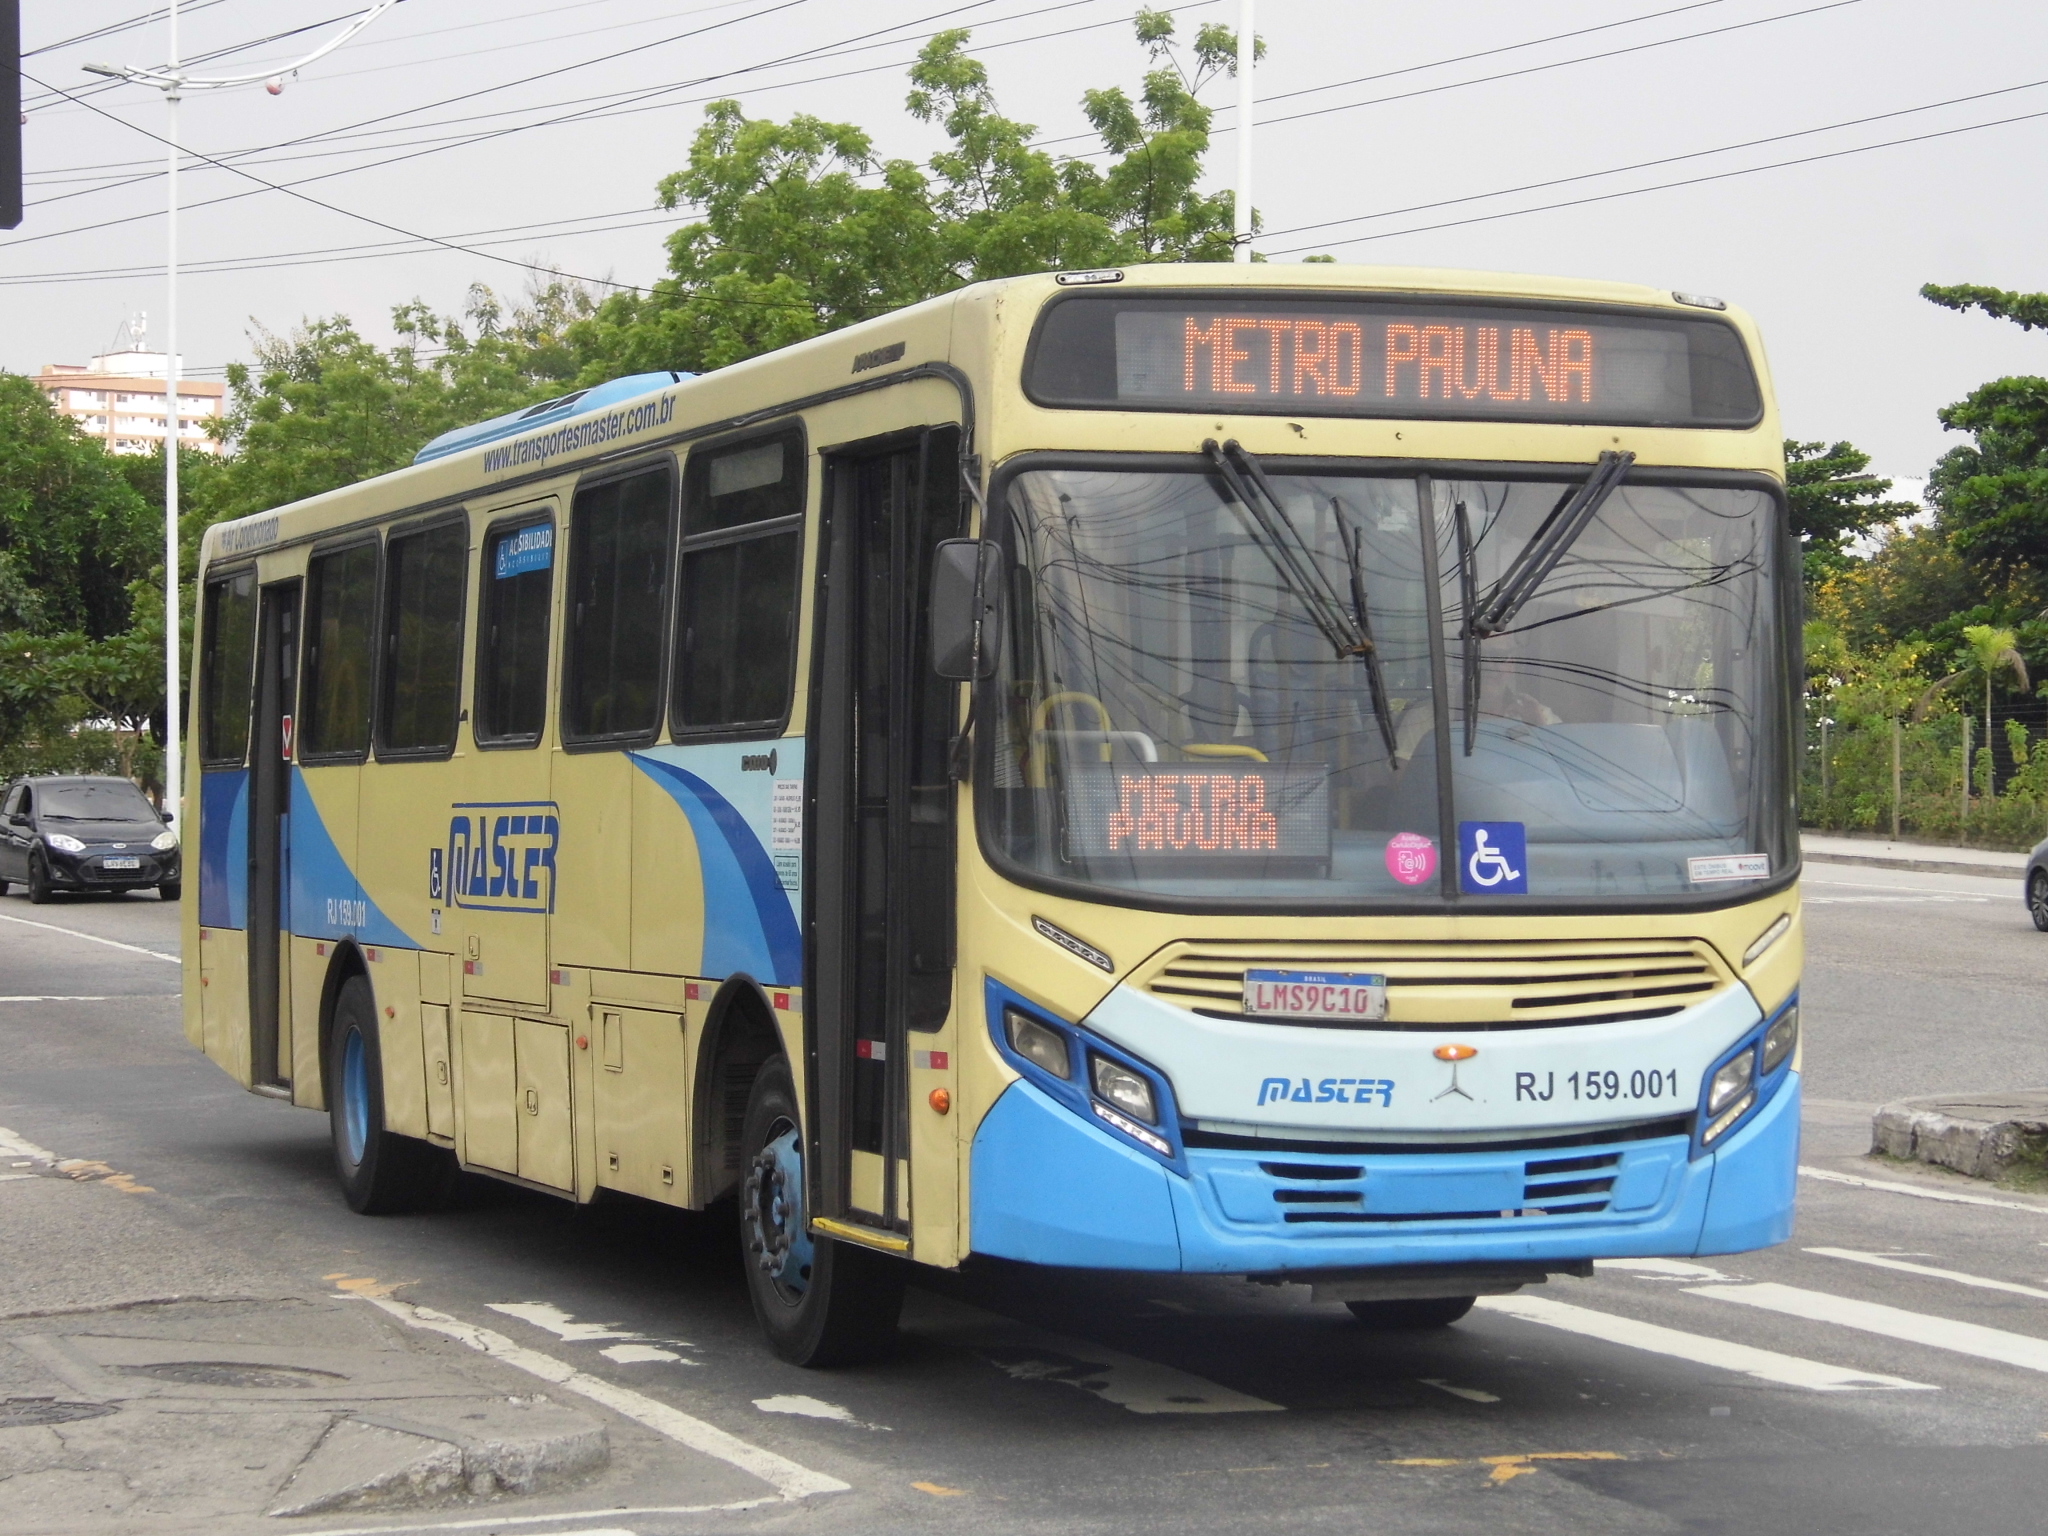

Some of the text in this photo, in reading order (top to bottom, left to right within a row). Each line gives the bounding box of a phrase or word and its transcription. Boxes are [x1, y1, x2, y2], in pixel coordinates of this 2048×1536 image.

[1185, 316, 1592, 402] METRO PAVUNA
[484, 391, 677, 474] www.transportesmaster.com.br
[1109, 811, 1276, 850] PAVUNA
[445, 814, 560, 915] MASTER
[327, 898, 337, 924] RJ
[1304, 975, 1327, 983] BRASIL
[1256, 983, 1368, 1014] LMS9C10
[1256, 1077, 1395, 1108] MASTER
[1515, 1068, 1677, 1101] RJ 159.001
